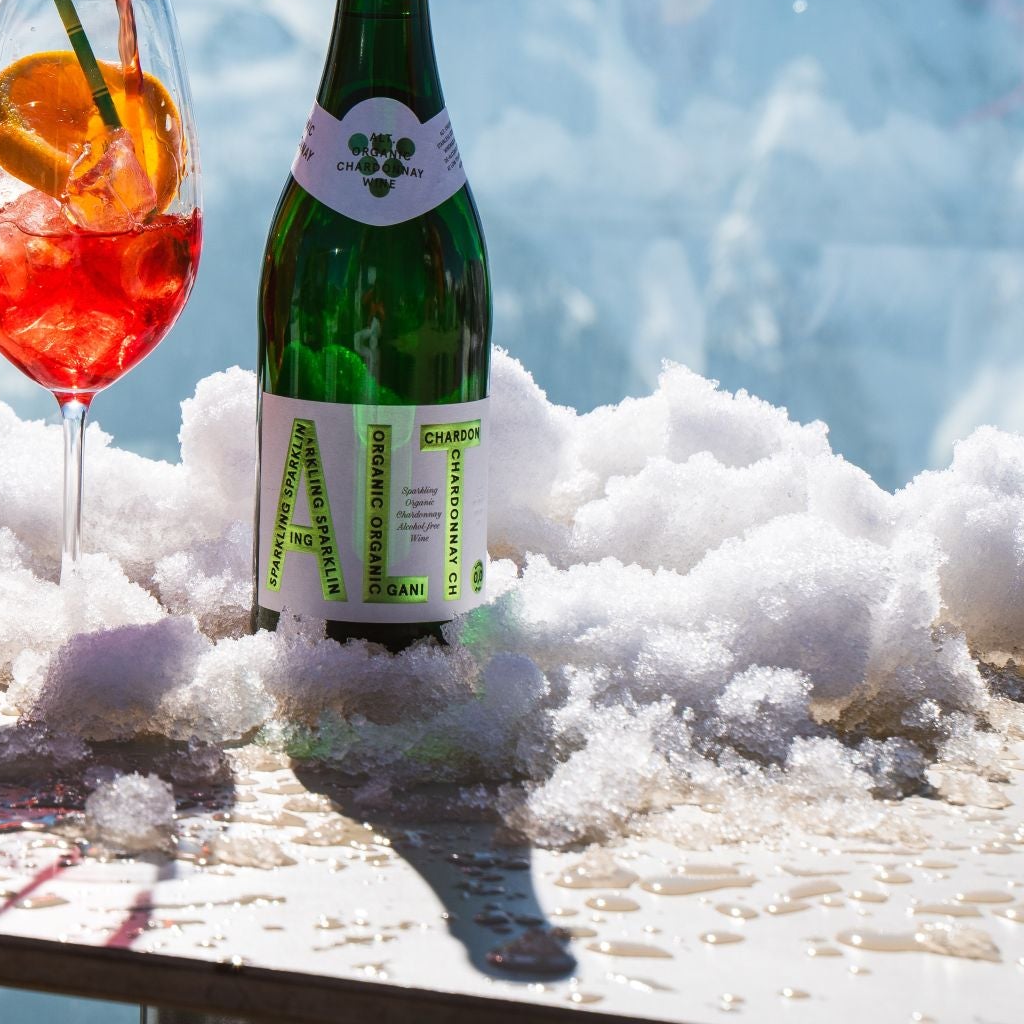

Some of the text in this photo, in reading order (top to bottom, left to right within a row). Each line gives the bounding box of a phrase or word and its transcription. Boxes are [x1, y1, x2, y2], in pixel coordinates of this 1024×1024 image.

[351, 146, 411, 161] ORGANIC
[336, 161, 424, 179] CHARDONNAY
[362, 177, 396, 189] WINE
[424, 427, 480, 444] CHARDON
[269, 423, 307, 587] SPARKLING SPARKLIN
[368, 430, 385, 595] ORGANIC ORGANIC
[448, 448, 461, 596] CHARDONNAY CH
[289, 531, 313, 546] ING
[315, 515, 341, 595] SPARKLIN
[386, 583, 424, 597] GANI
